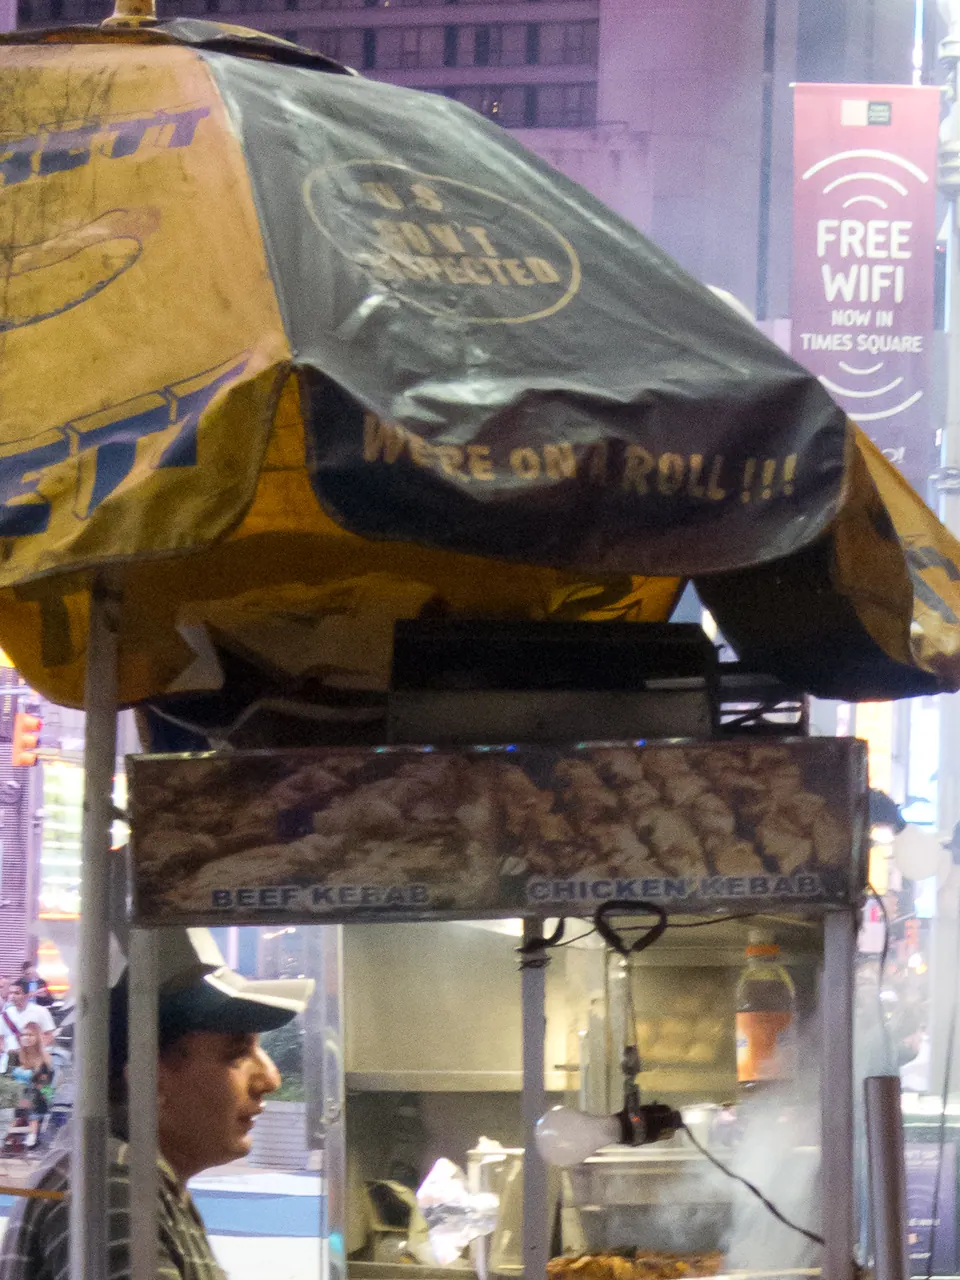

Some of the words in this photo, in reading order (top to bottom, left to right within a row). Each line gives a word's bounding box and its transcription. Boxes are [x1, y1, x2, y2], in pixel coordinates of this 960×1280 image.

[816, 219, 913, 259] FREE
[821, 264, 904, 303] WIFI
[831, 309, 871, 326] NOW
[876, 310, 894, 327] IN
[800, 333, 853, 351] TIMES
[856, 334, 923, 354] SQUARE
[510, 442, 577, 479] ON
[622, 444, 725, 501] ROLL
[212, 886, 299, 908] BEEF
[311, 882, 430, 905] KEBAB
[527, 877, 688, 901] CHICKEN
[700, 873, 820, 897] KEBAB
